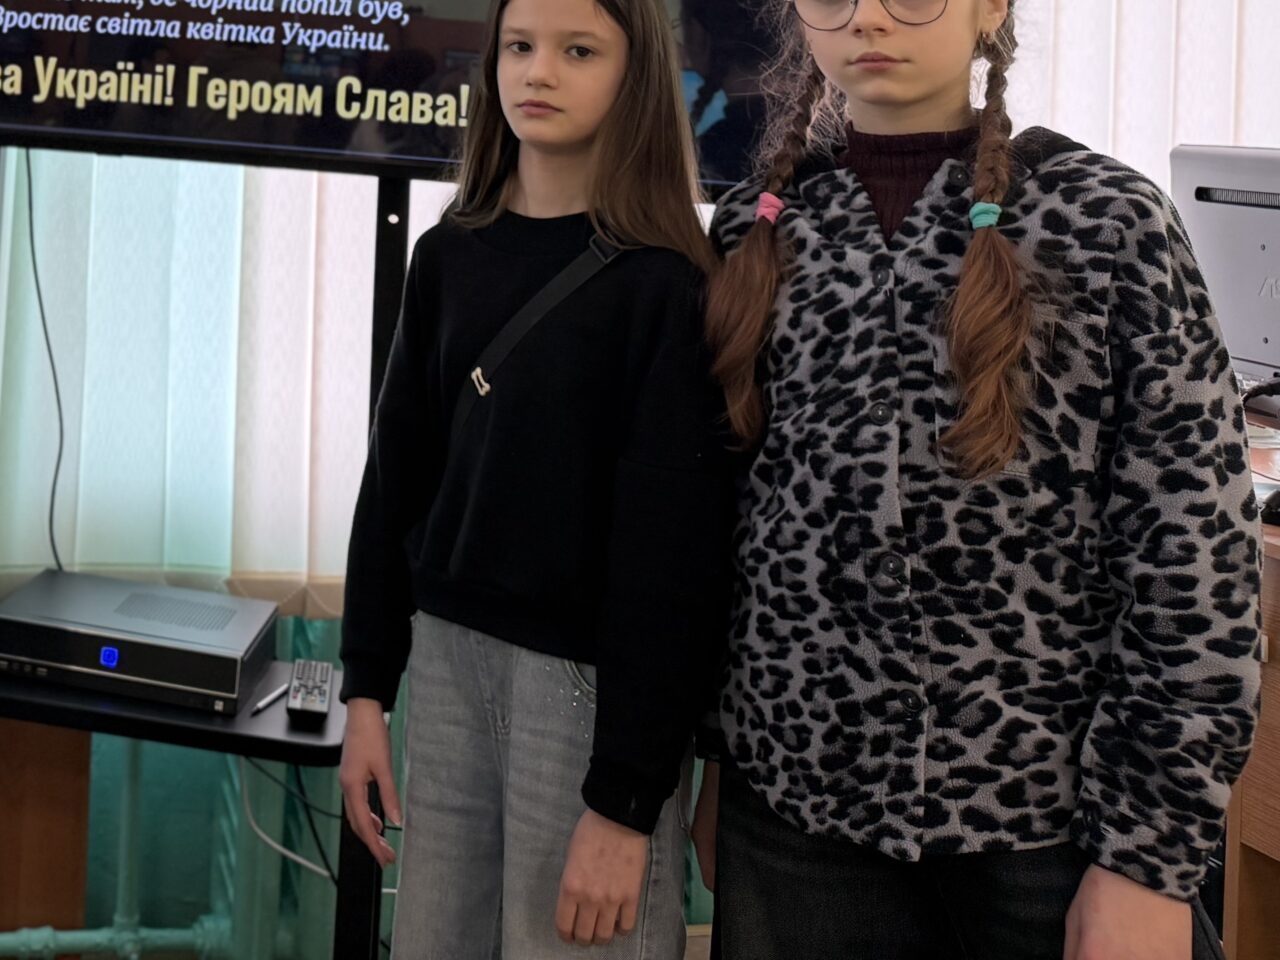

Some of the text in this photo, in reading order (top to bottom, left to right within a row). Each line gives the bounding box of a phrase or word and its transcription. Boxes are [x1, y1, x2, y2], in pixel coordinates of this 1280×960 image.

[95, 11, 181, 39] світла
[186, 16, 276, 45] квітка
[281, 21, 390, 53] України.
[33, 55, 176, 108] Україні!
[187, 66, 323, 120] Героям
[336, 75, 470, 127] Слава!
